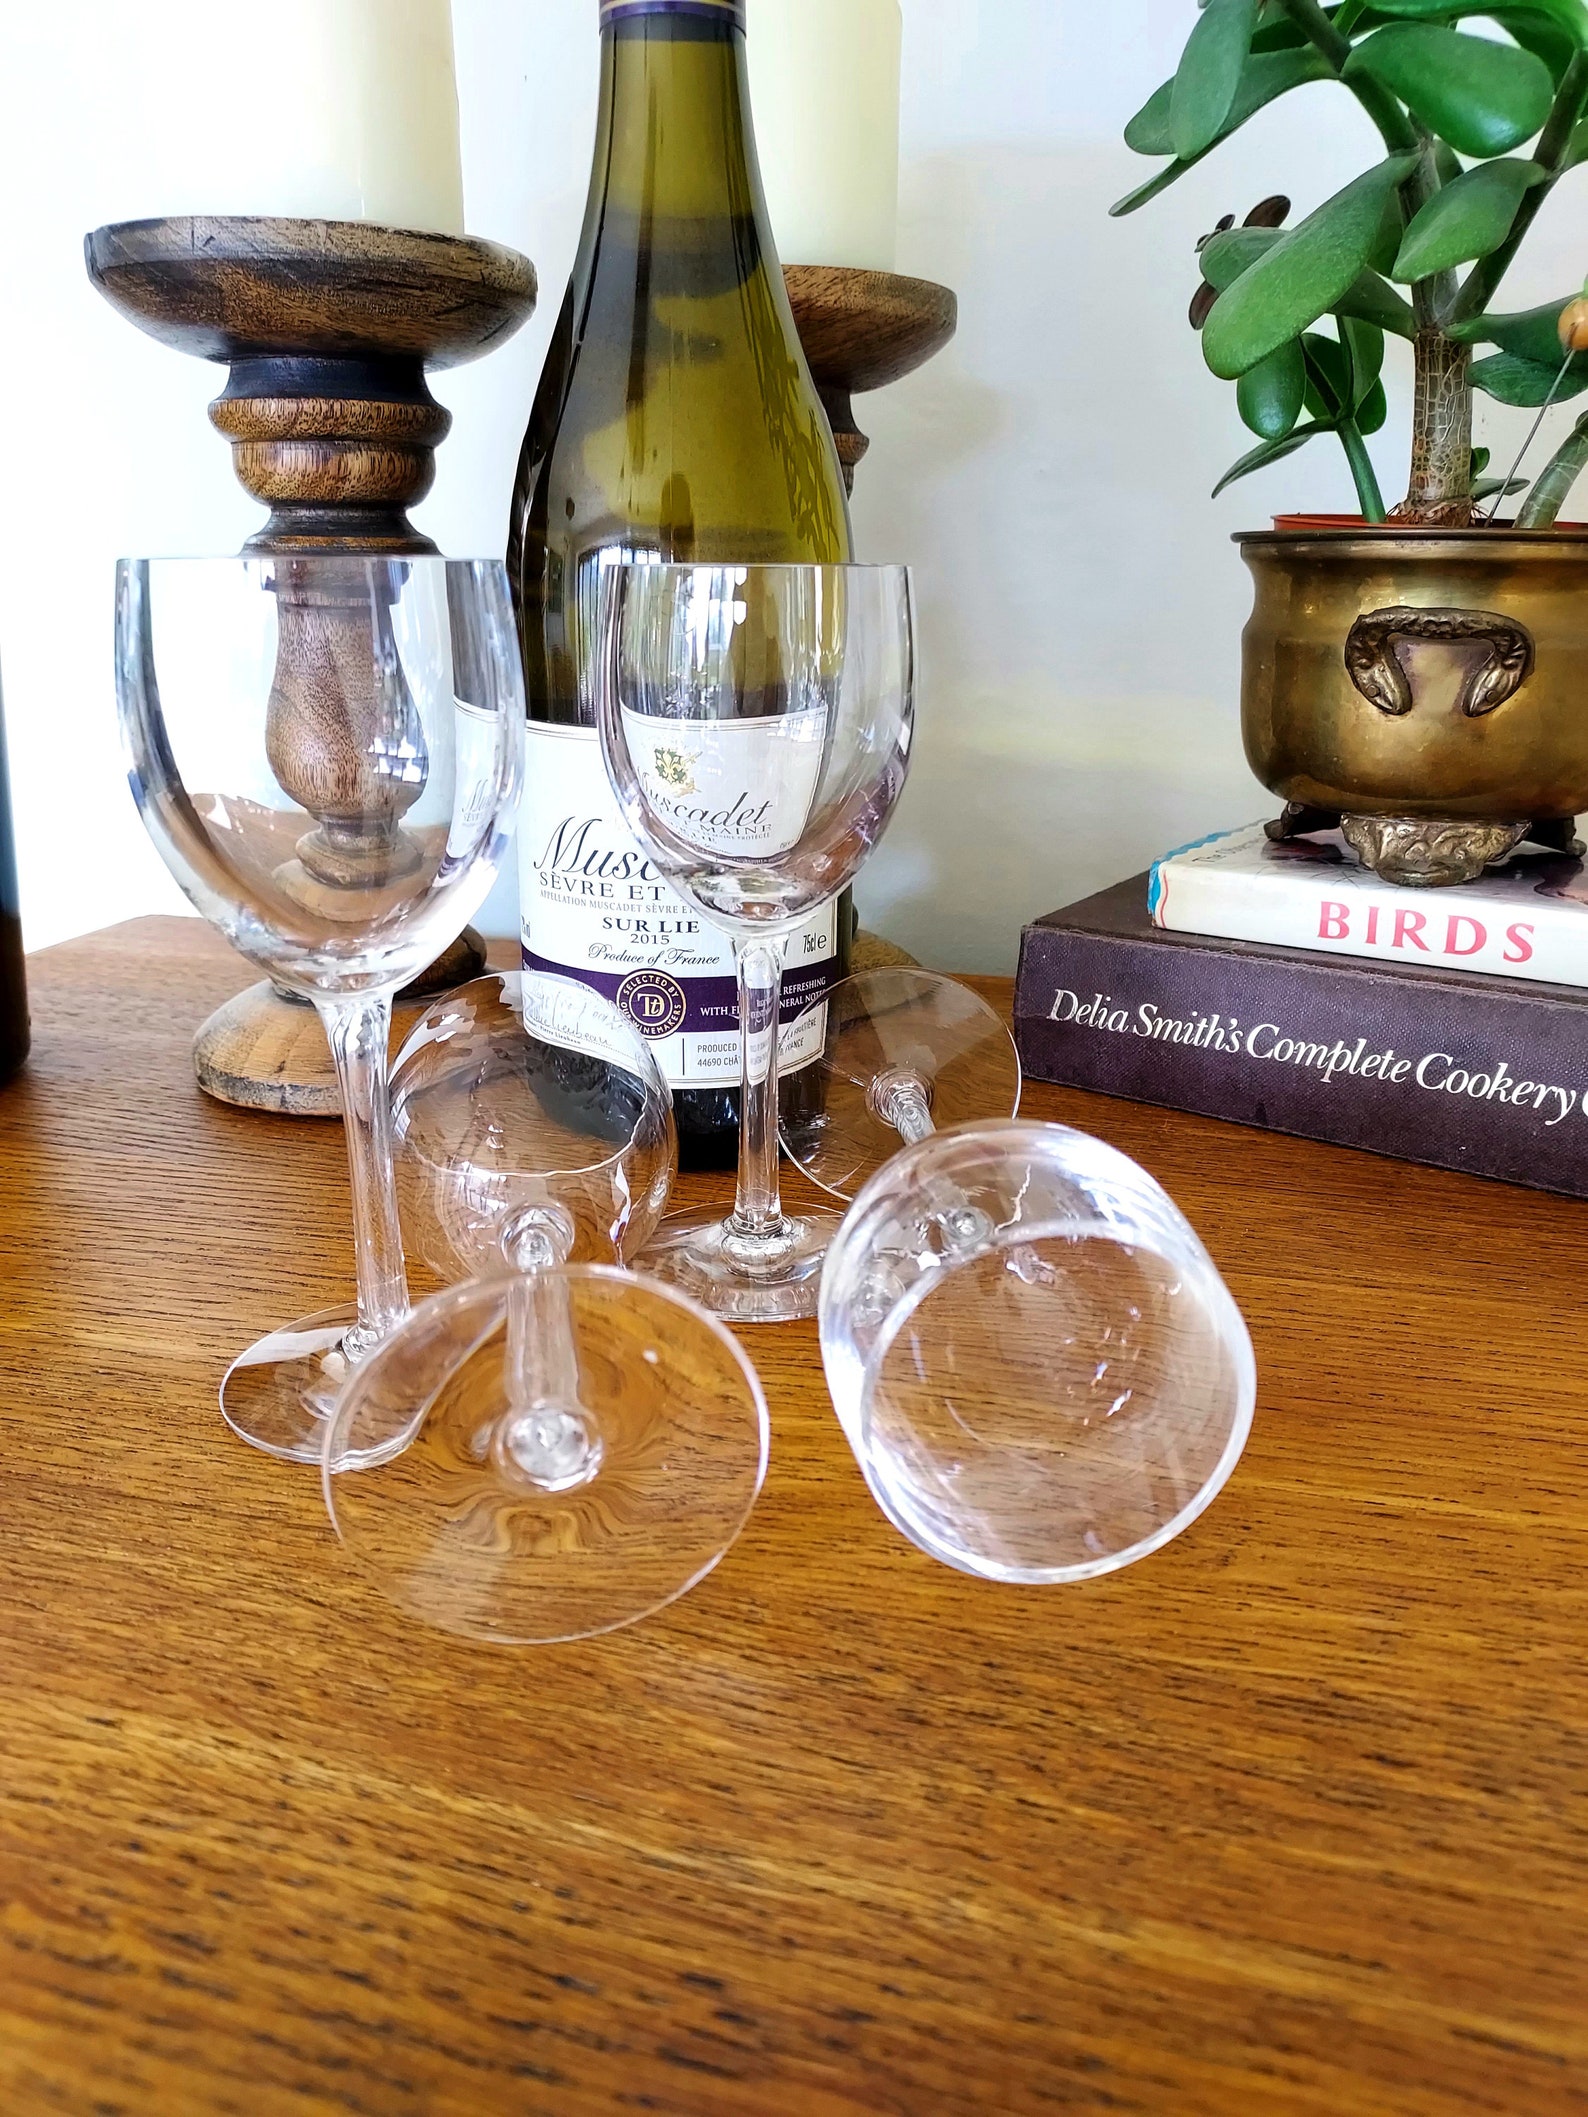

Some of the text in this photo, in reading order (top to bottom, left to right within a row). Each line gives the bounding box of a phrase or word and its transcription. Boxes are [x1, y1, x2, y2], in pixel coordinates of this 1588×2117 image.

[539, 871, 666, 901] SÈVRE ET
[540, 888, 587, 907] APPELLATION
[589, 900, 643, 913] MUSCADET
[645, 903, 679, 914] SÈVRE
[602, 916, 700, 934] SUR LIE
[1317, 901, 1536, 964] BIRDS
[630, 933, 670, 945] 2015
[588, 942, 720, 968] Produce of France
[623, 975, 680, 998] SELECTED BY
[783, 976, 827, 996] REFRESHING
[632, 1003, 682, 1035] WINEMAKERS
[700, 1006, 728, 1017] WITH
[697, 1042, 738, 1054] PRODUCED
[1046, 988, 1129, 1034] Delia
[1245, 1023, 1412, 1083] Complete
[1415, 1052, 1577, 1127] Cookery
[697, 1057, 722, 1068] 44690
